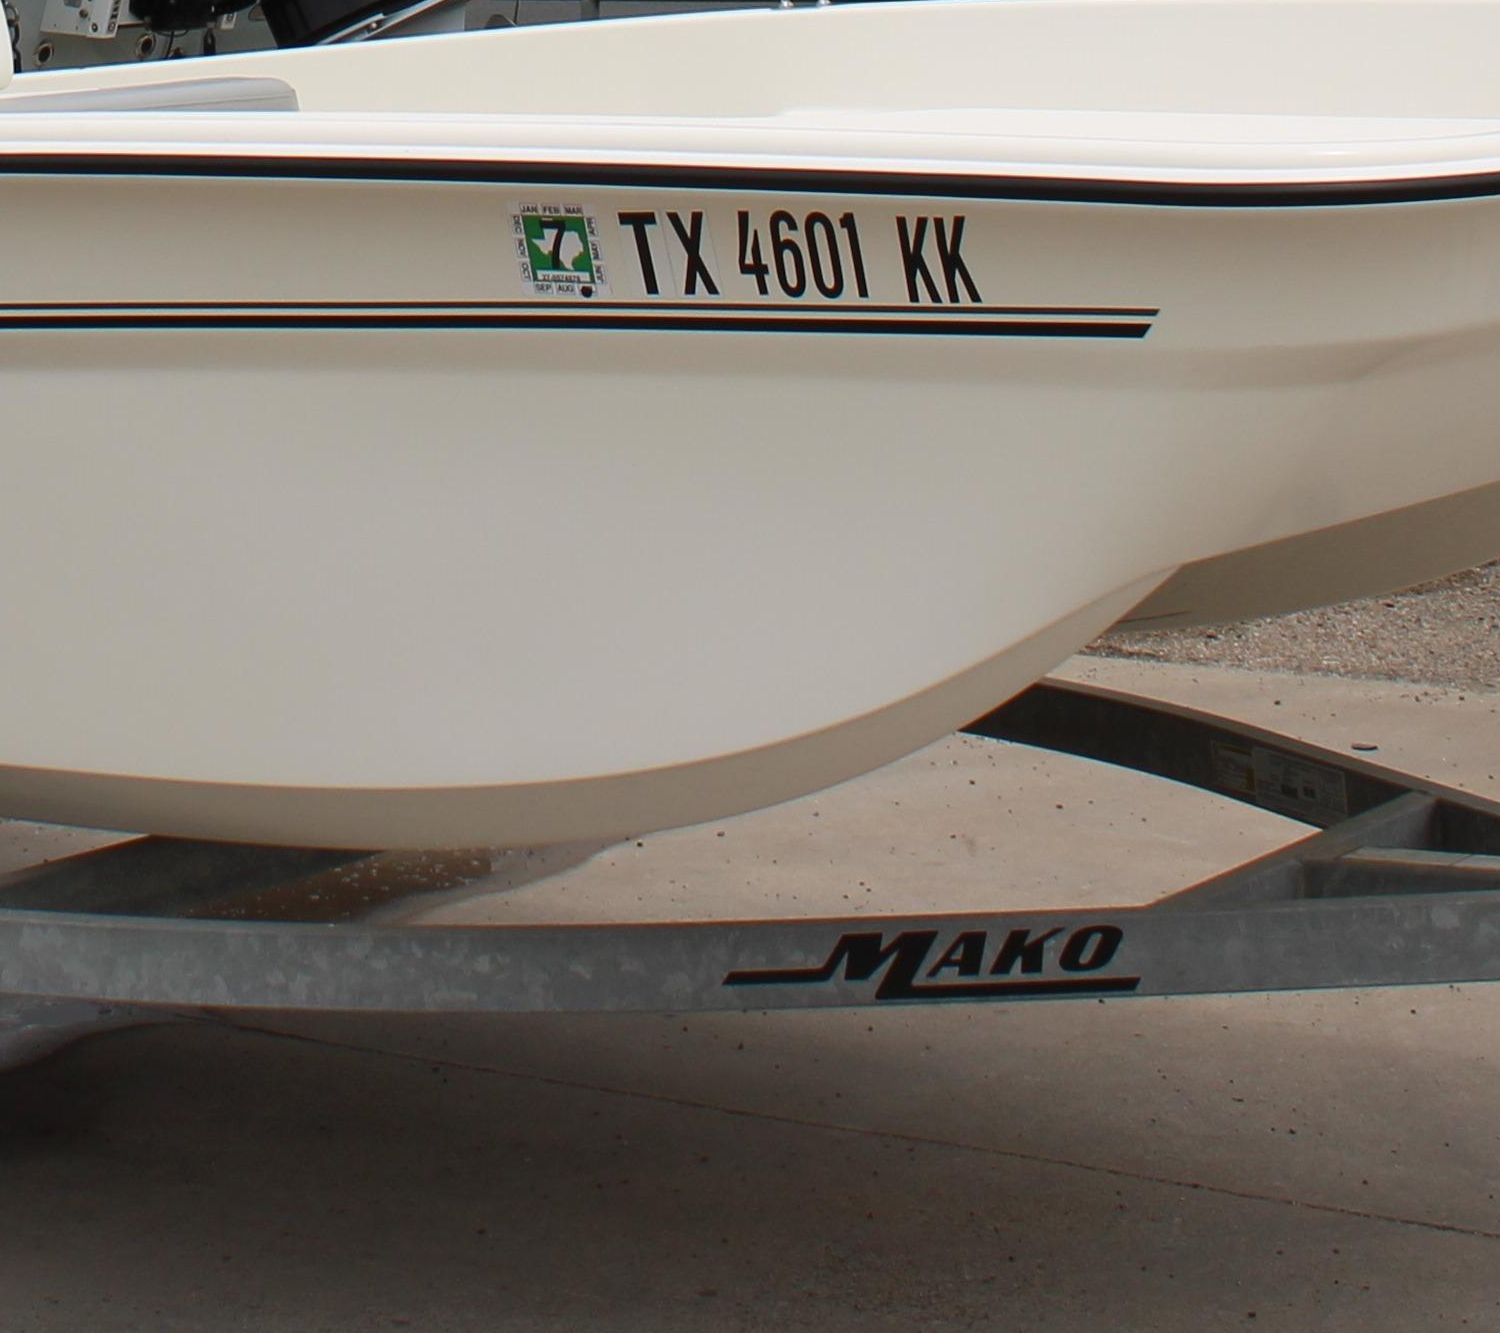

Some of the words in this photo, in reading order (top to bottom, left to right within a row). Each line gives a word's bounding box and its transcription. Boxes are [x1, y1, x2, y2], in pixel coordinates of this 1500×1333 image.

[617, 211, 720, 295] TX
[737, 211, 869, 298] 4601
[895, 215, 983, 303] KK
[722, 925, 1141, 1000] MAKO
